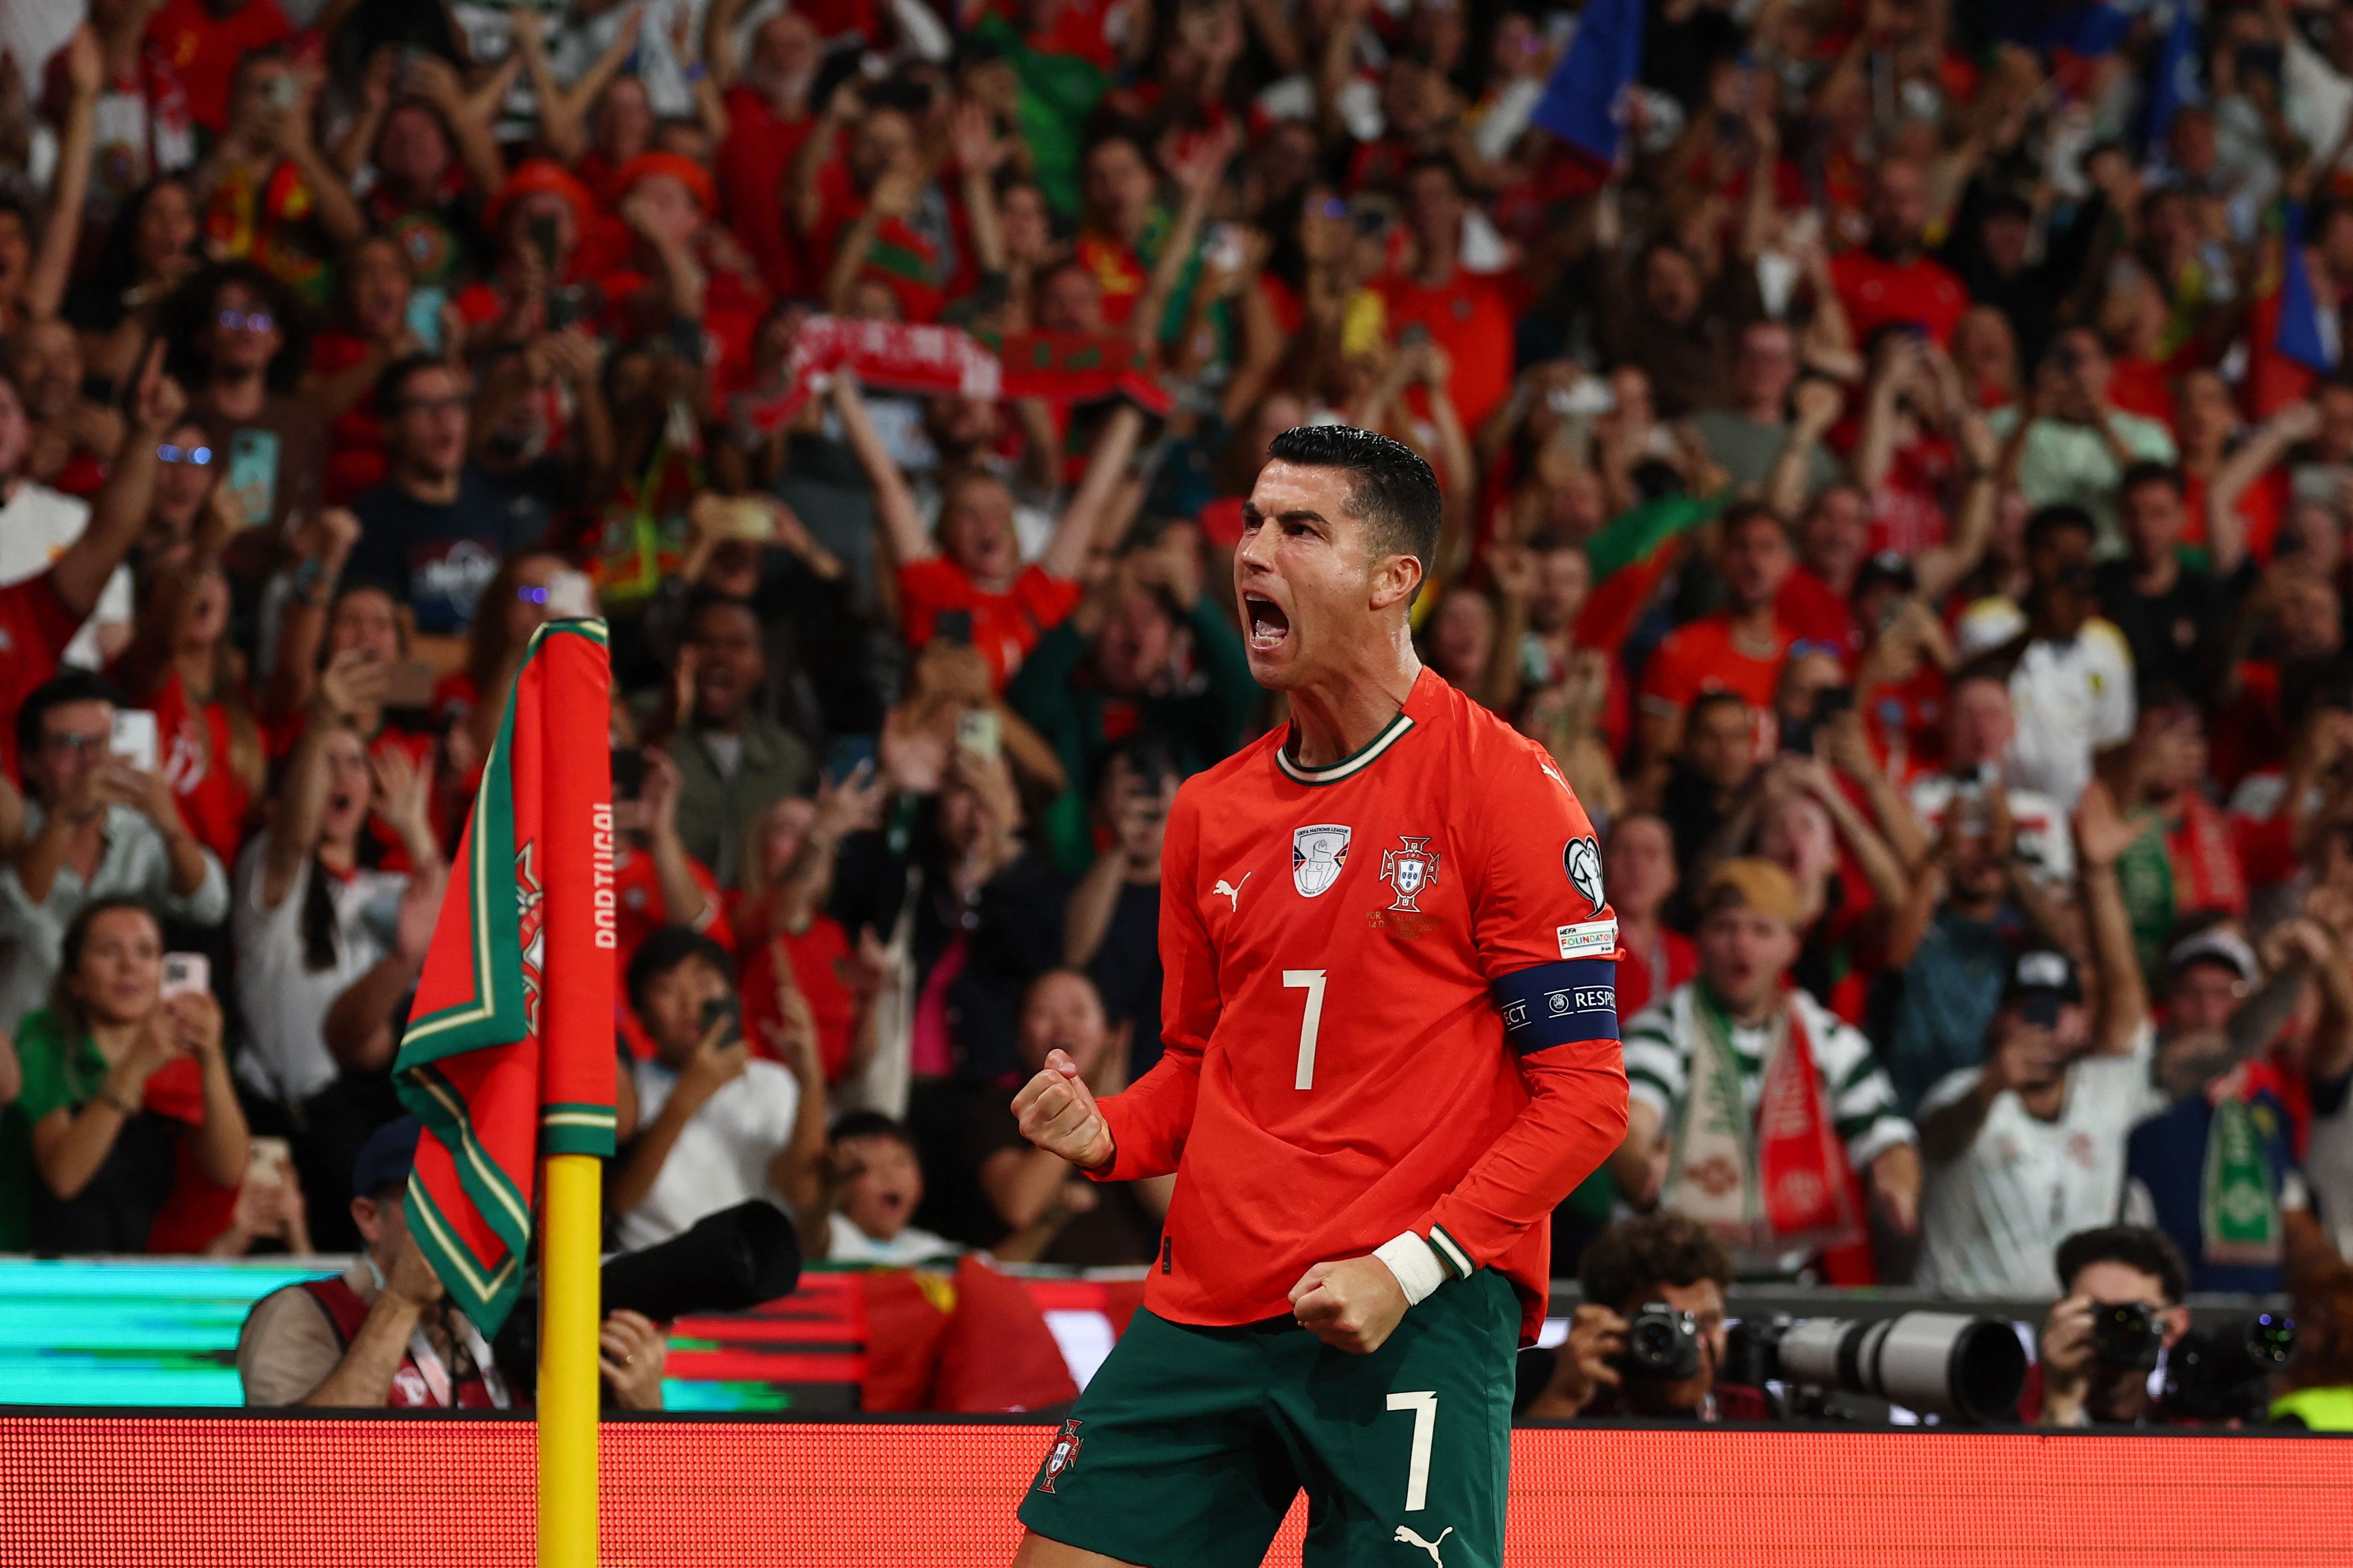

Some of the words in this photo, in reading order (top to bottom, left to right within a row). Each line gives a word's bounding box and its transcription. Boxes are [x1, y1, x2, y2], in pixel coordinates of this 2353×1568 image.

[1368, 920, 1376, 928] 14
[1561, 934, 1612, 947] FOUNDATION
[1283, 970, 1327, 1089] 7
[1386, 1391, 1438, 1511] 7
